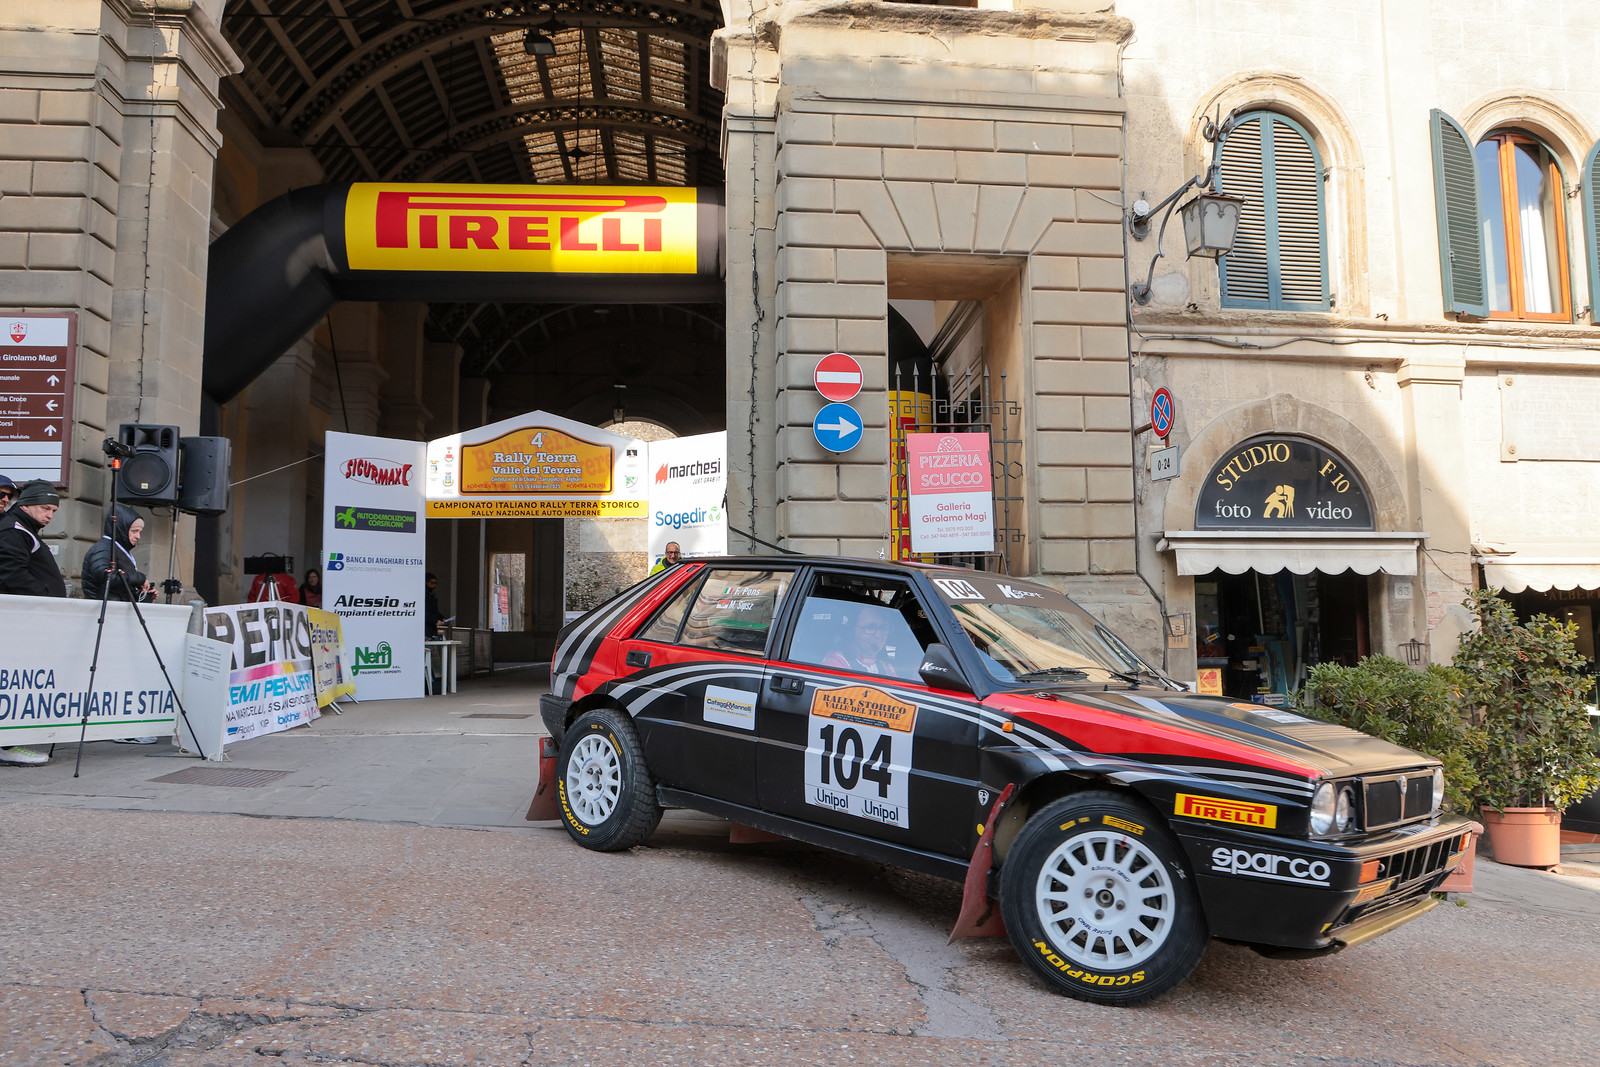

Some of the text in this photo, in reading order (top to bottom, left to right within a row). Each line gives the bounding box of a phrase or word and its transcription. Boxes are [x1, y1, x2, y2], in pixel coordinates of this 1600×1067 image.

[376, 191, 667, 251] PIRELLI
[2, 354, 57, 362] Girolamo Magi
[493, 452, 578, 465] Rally Terra
[669, 458, 720, 478] marchesi
[919, 454, 983, 468] PIZZERIA
[1216, 442, 1350, 494] STUDIO F 10
[492, 466, 582, 475] Valle del Tevere
[920, 472, 983, 487] SCUCCO
[936, 502, 971, 511] Galleria
[1215, 499, 1352, 520] foto video
[655, 507, 706, 530] Sogedir
[922, 512, 987, 523] Girolamo Magi
[346, 556, 366, 564] BANCA
[368, 556, 374, 564] DI
[375, 556, 404, 564] ANGHIARI
[410, 558, 423, 566] STIA
[734, 587, 761, 596] F. Pons
[938, 580, 981, 598] 104
[1397, 586, 1410, 596] 83
[334, 595, 416, 608] Alessio srl
[334, 608, 416, 618] impianti elettrici
[0, 669, 55, 690] BANCA
[20, 692, 118, 720] ANGHIARI
[123, 691, 133, 715] E
[138, 690, 175, 714] STIA
[823, 694, 907, 715] RALLY STORICO
[825, 702, 849, 711] VALLE
[851, 706, 866, 714] DEL
[868, 708, 901, 720] TEVERE
[820, 724, 892, 798] 104
[559, 779, 590, 835] SCORPION
[816, 788, 898, 822] Unipol Unipol
[1184, 796, 1266, 826] PIRELLI
[1212, 847, 1331, 881] sparco
[1034, 941, 1146, 986] SCORPION
